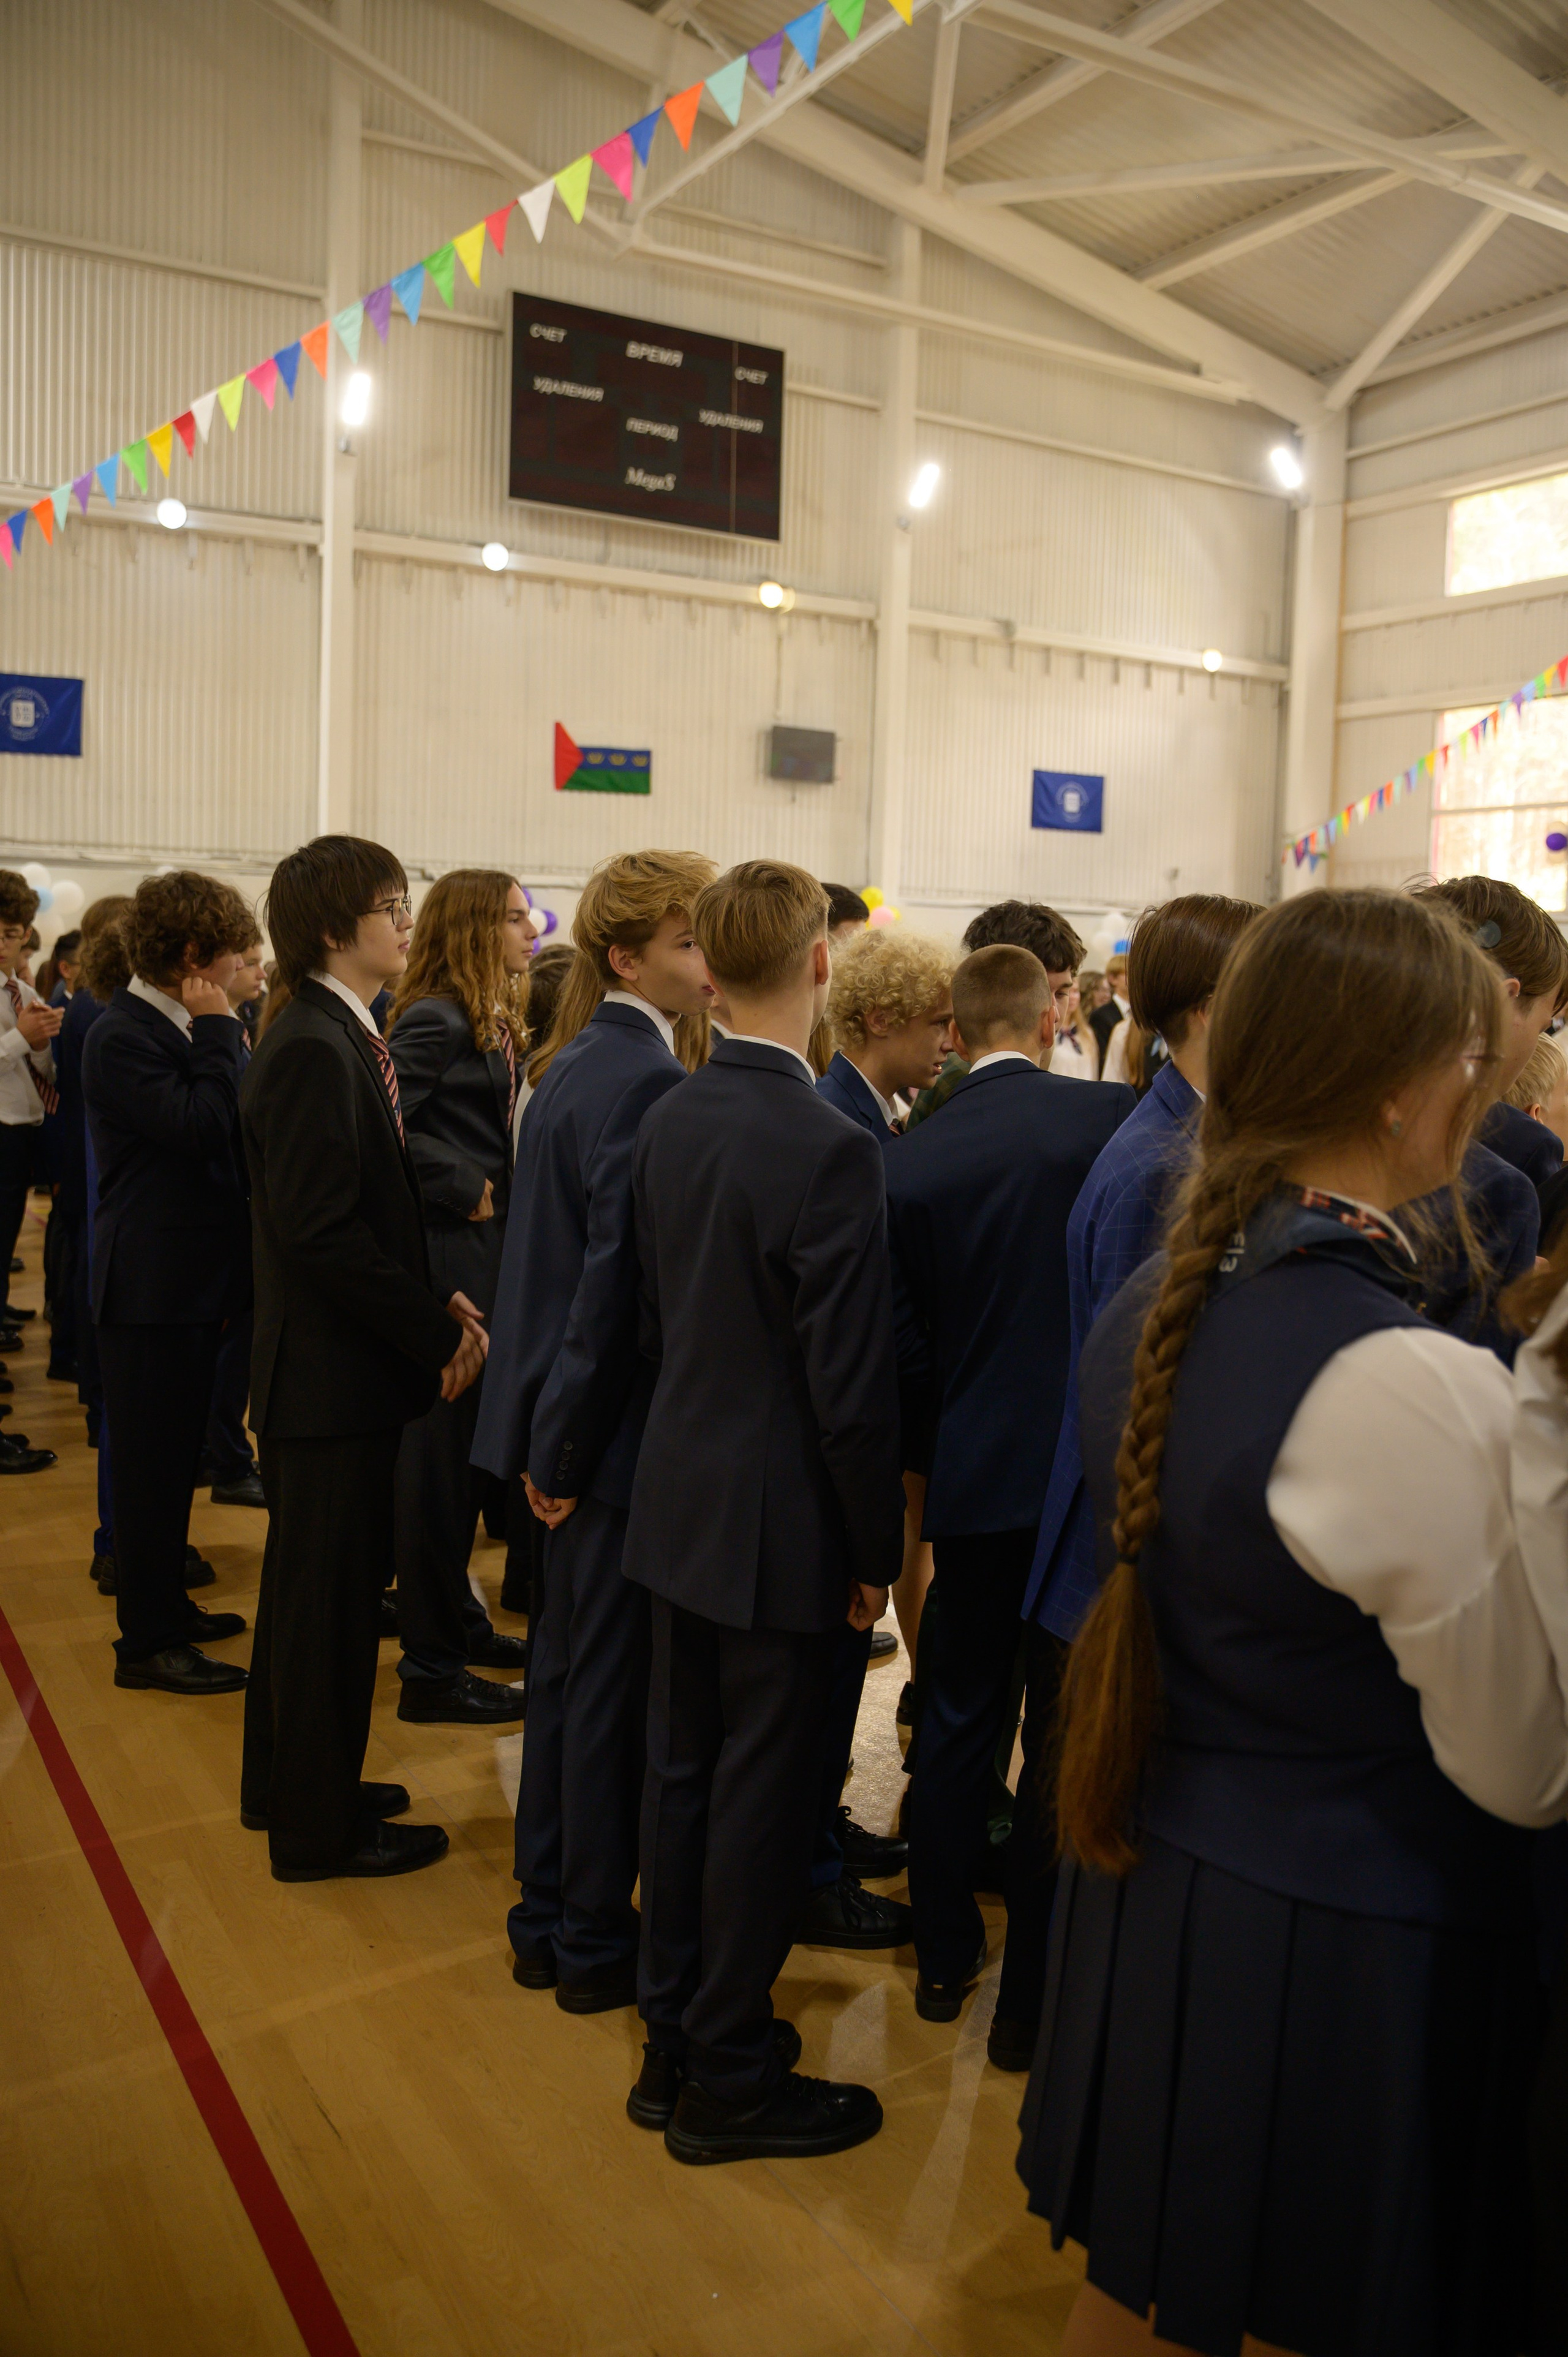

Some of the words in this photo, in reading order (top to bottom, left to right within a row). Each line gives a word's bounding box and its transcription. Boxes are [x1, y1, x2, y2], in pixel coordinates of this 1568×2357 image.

[530, 323, 567, 342] СЧЕТ
[625, 341, 683, 368] ВРЕМЯ
[734, 366, 768, 385] СЧЕТ
[532, 376, 604, 402] УДАЛЕНИЯ
[626, 417, 679, 442] ПЕРИОД
[699, 409, 763, 433] УДАЛЕНИЯ
